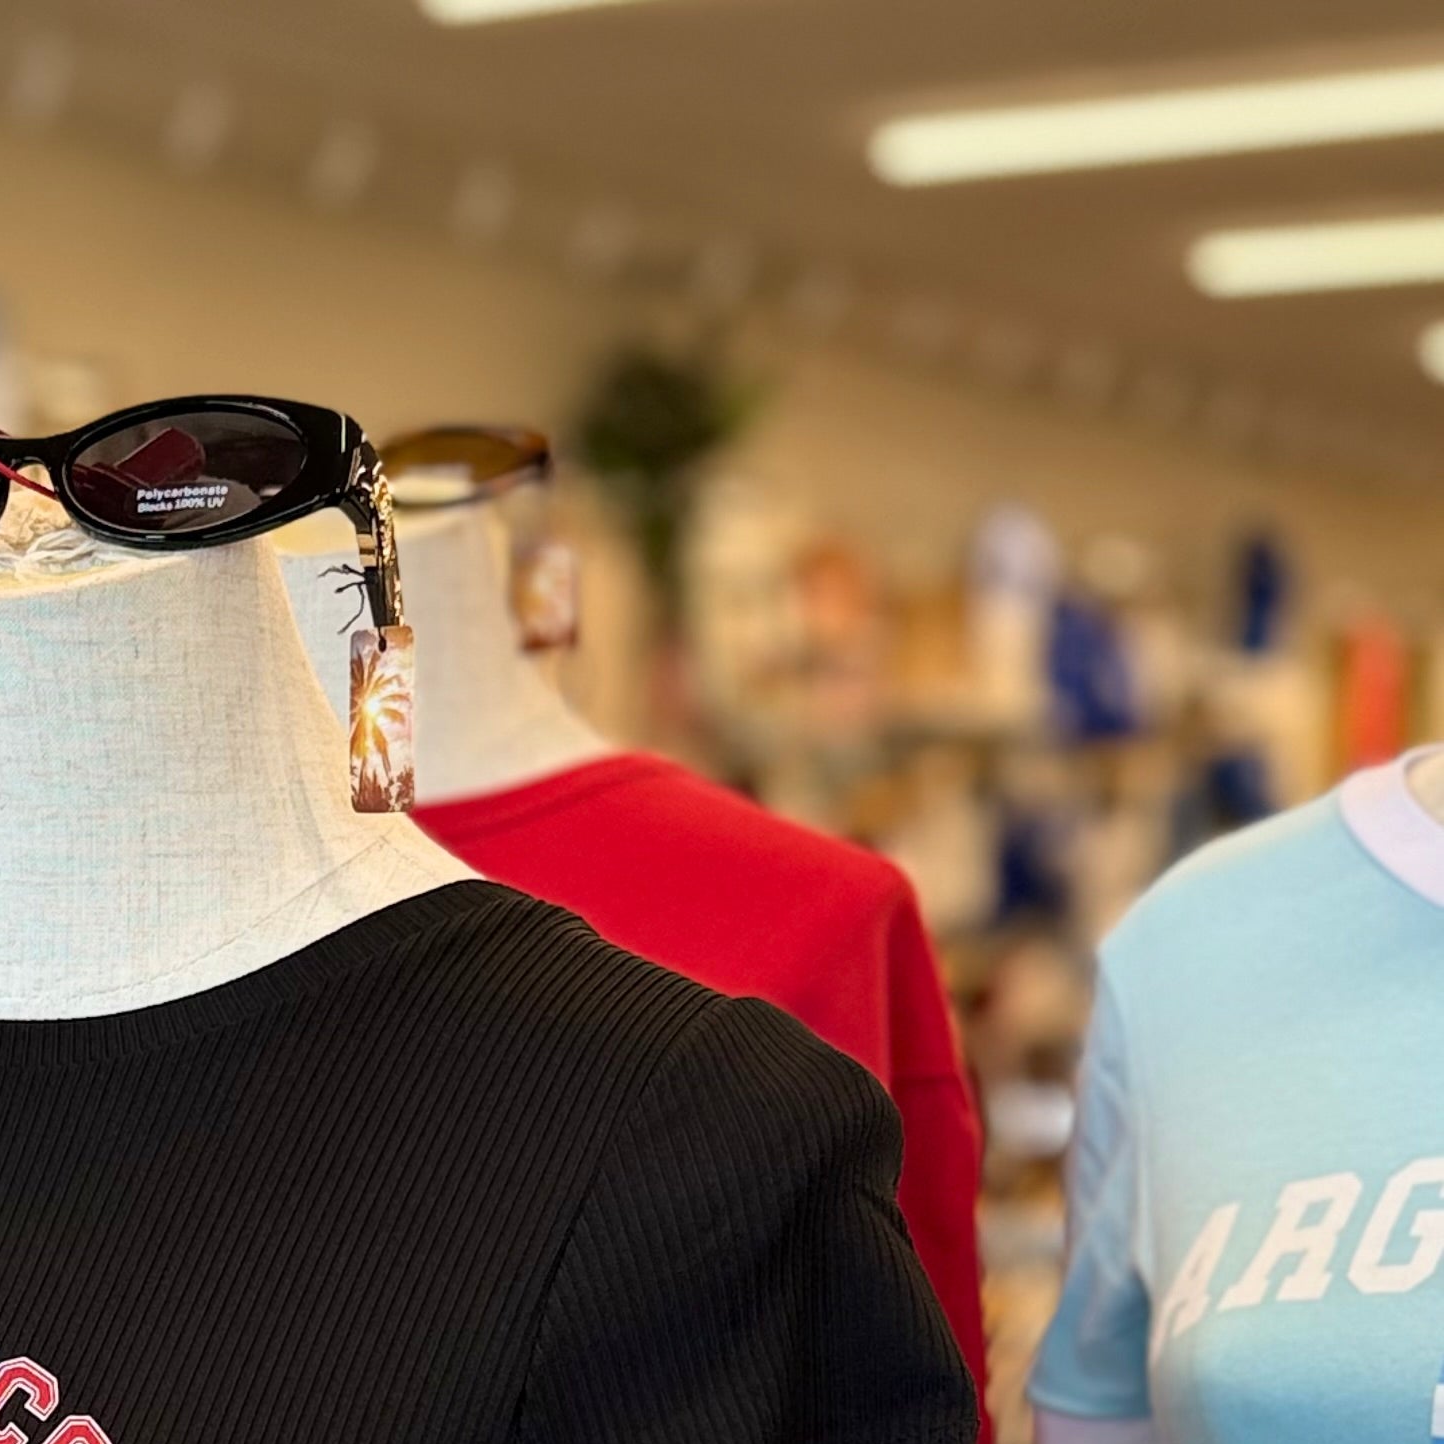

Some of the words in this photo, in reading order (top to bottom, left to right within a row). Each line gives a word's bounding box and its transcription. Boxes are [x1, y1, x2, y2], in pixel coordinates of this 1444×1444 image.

[136, 485, 229, 501] Polycarbonate
[137, 502, 173, 513] Blocks
[174, 498, 205, 510] 100%
[206, 496, 226, 509] UV
